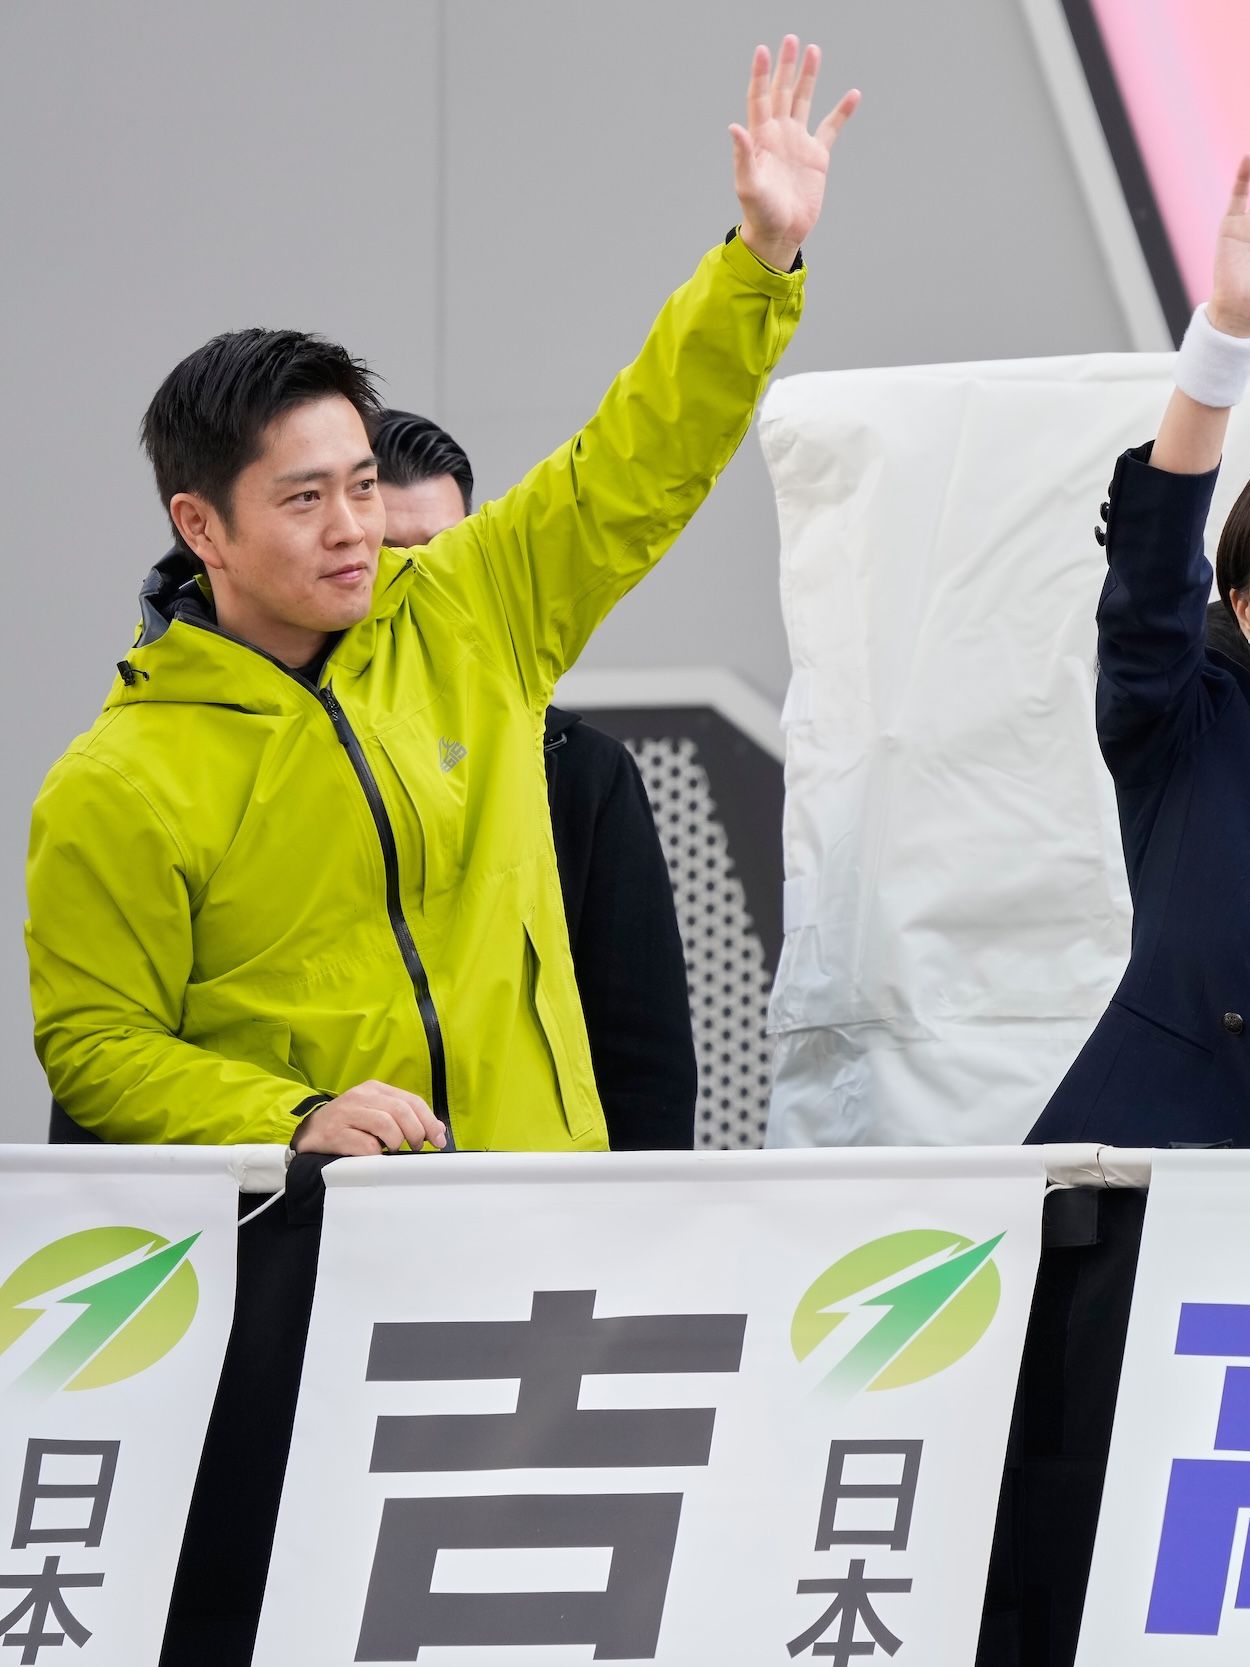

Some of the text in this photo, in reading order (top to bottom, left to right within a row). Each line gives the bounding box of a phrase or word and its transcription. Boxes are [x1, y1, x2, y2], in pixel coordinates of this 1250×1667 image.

[0, 1438, 121, 1666] 日本
[354, 1289, 748, 1663] 吉
[786, 1439, 924, 1667] 日本
